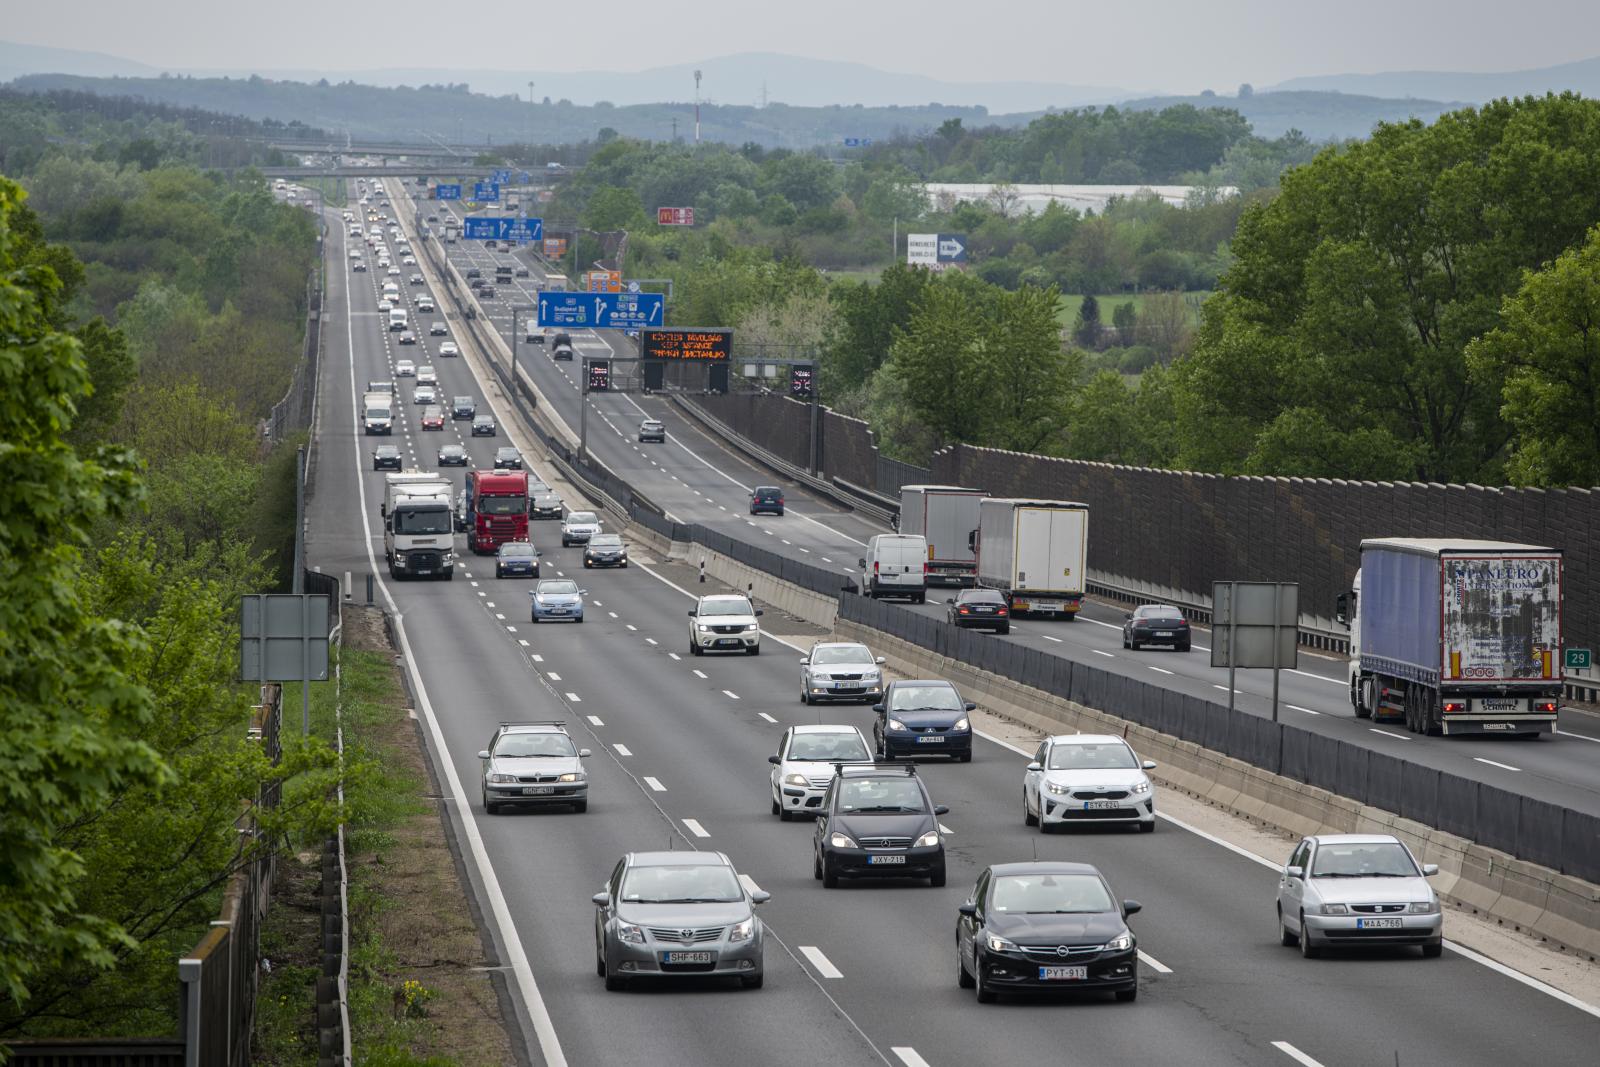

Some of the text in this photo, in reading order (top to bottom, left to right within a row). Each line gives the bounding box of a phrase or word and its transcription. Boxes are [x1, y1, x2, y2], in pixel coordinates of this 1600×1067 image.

[1467, 569, 1539, 580] PANEURO
[1571, 653, 1585, 664] 29
[1089, 801, 1118, 809] STK-624
[873, 856, 904, 864] JXY-715
[671, 953, 709, 961] SHF-663
[1047, 969, 1086, 977] PYT-913
